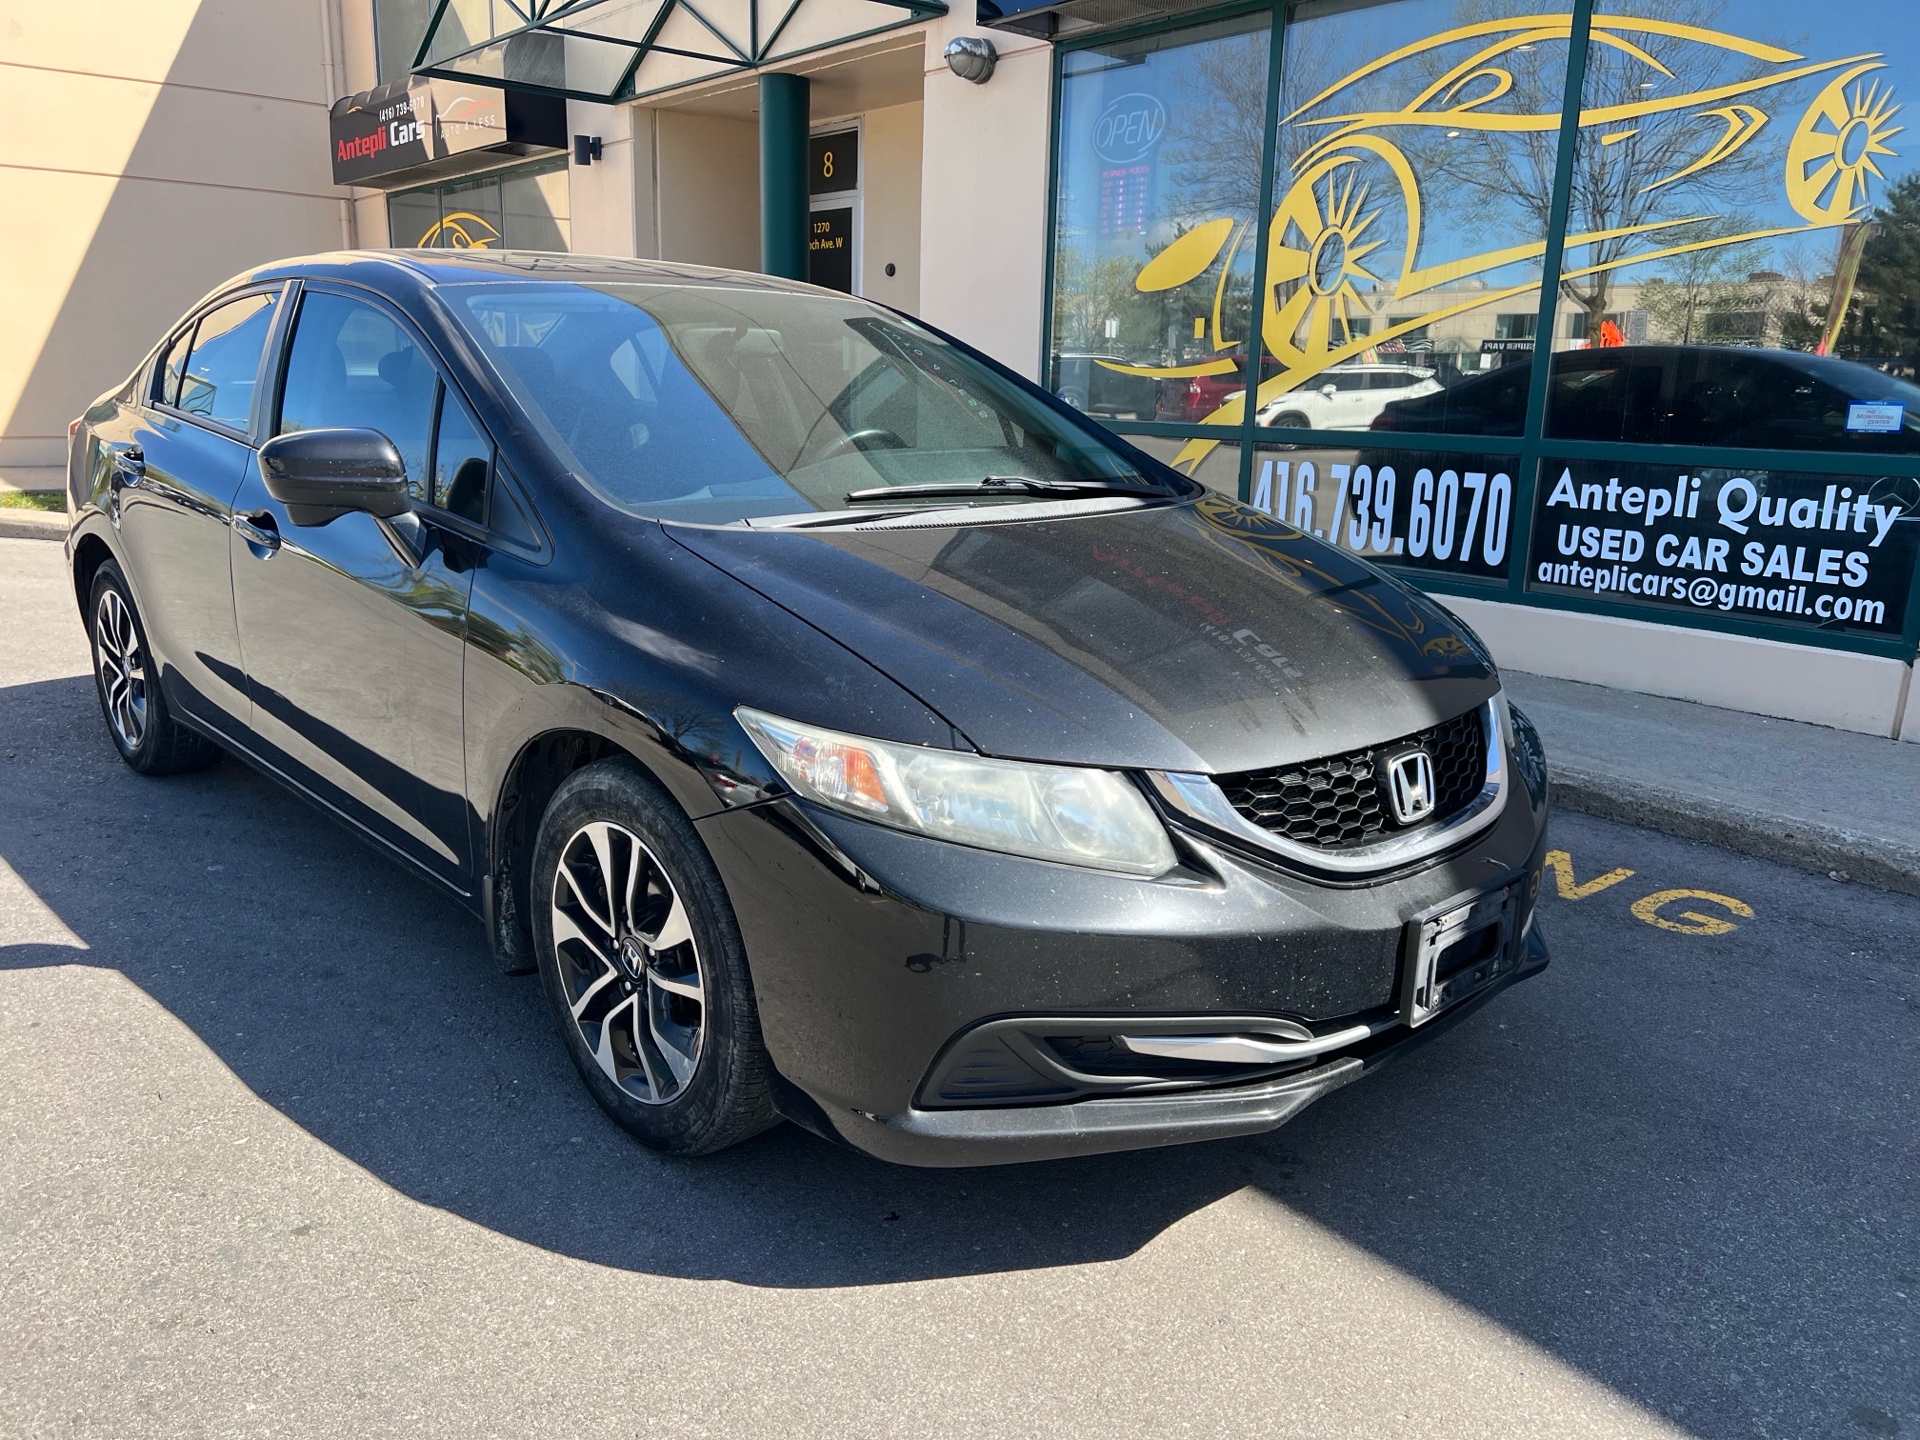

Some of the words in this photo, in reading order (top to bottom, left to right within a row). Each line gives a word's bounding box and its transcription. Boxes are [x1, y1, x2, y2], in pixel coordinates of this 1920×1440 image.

[379, 106, 395, 122] (416)
[440, 124, 460, 140] AUTO
[464, 121, 469, 131] 4
[473, 114, 496, 129] LESS
[1096, 108, 1158, 148] OPEN
[337, 125, 387, 163] Antepli
[389, 119, 426, 147] Cars
[823, 151, 834, 178] 8
[813, 221, 831, 234] 1270
[820, 238, 835, 250] Ave.
[835, 237, 844, 248] W
[1253, 460, 1512, 566] 416.739.6070
[1546, 467, 1701, 526] Antepli
[1717, 477, 1902, 547] Quality
[1557, 524, 1645, 563] USED
[1656, 533, 1730, 573] CAR
[1741, 541, 1869, 588] SALES
[1537, 560, 1886, 624] anteplicars@gmail.com
